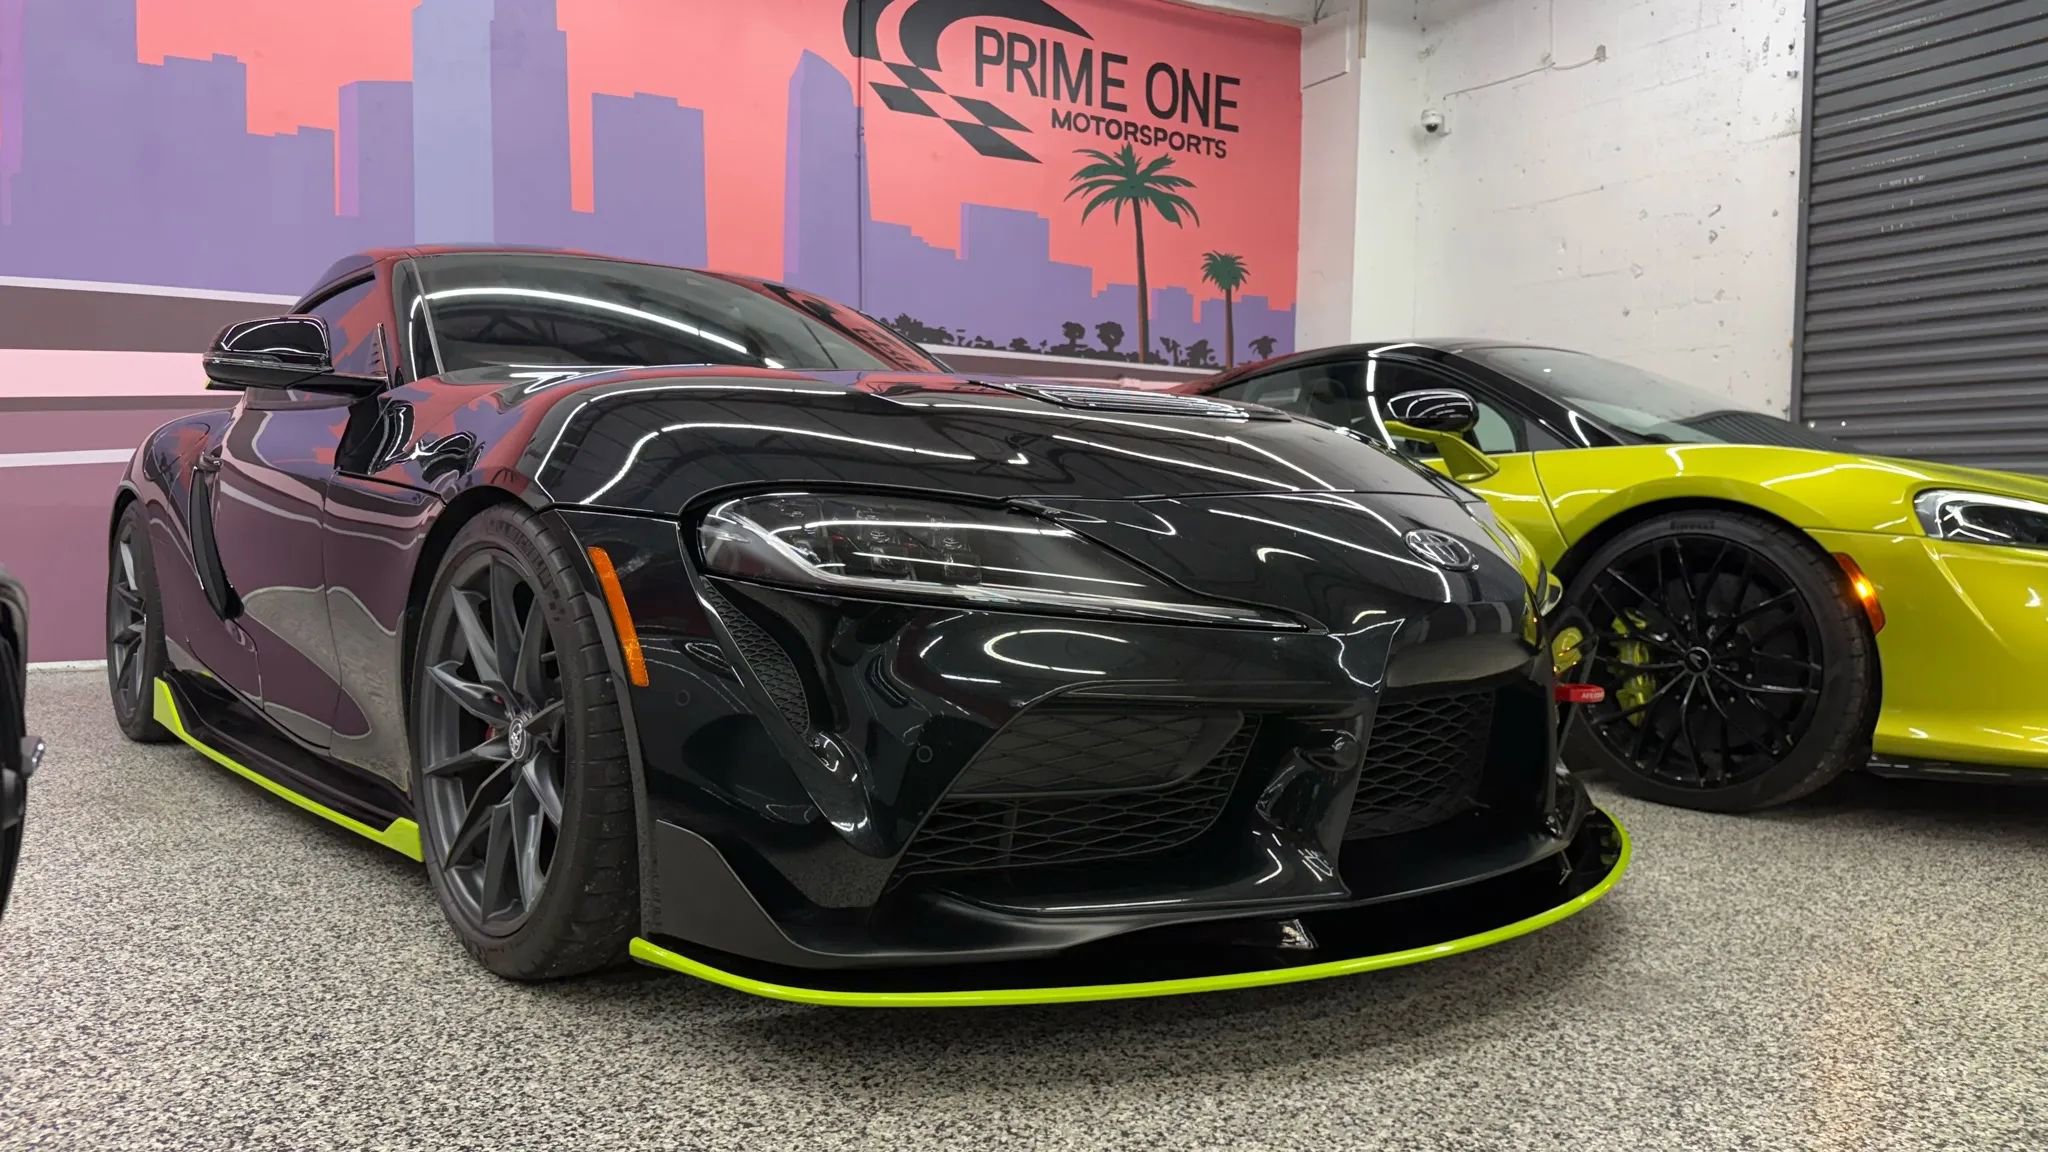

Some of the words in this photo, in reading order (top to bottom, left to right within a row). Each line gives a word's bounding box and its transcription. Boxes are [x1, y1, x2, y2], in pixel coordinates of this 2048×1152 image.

[975, 25, 1128, 113] PRIME
[1146, 62, 1240, 133] ONE
[1051, 107, 1227, 159] MOTORSPORTS
